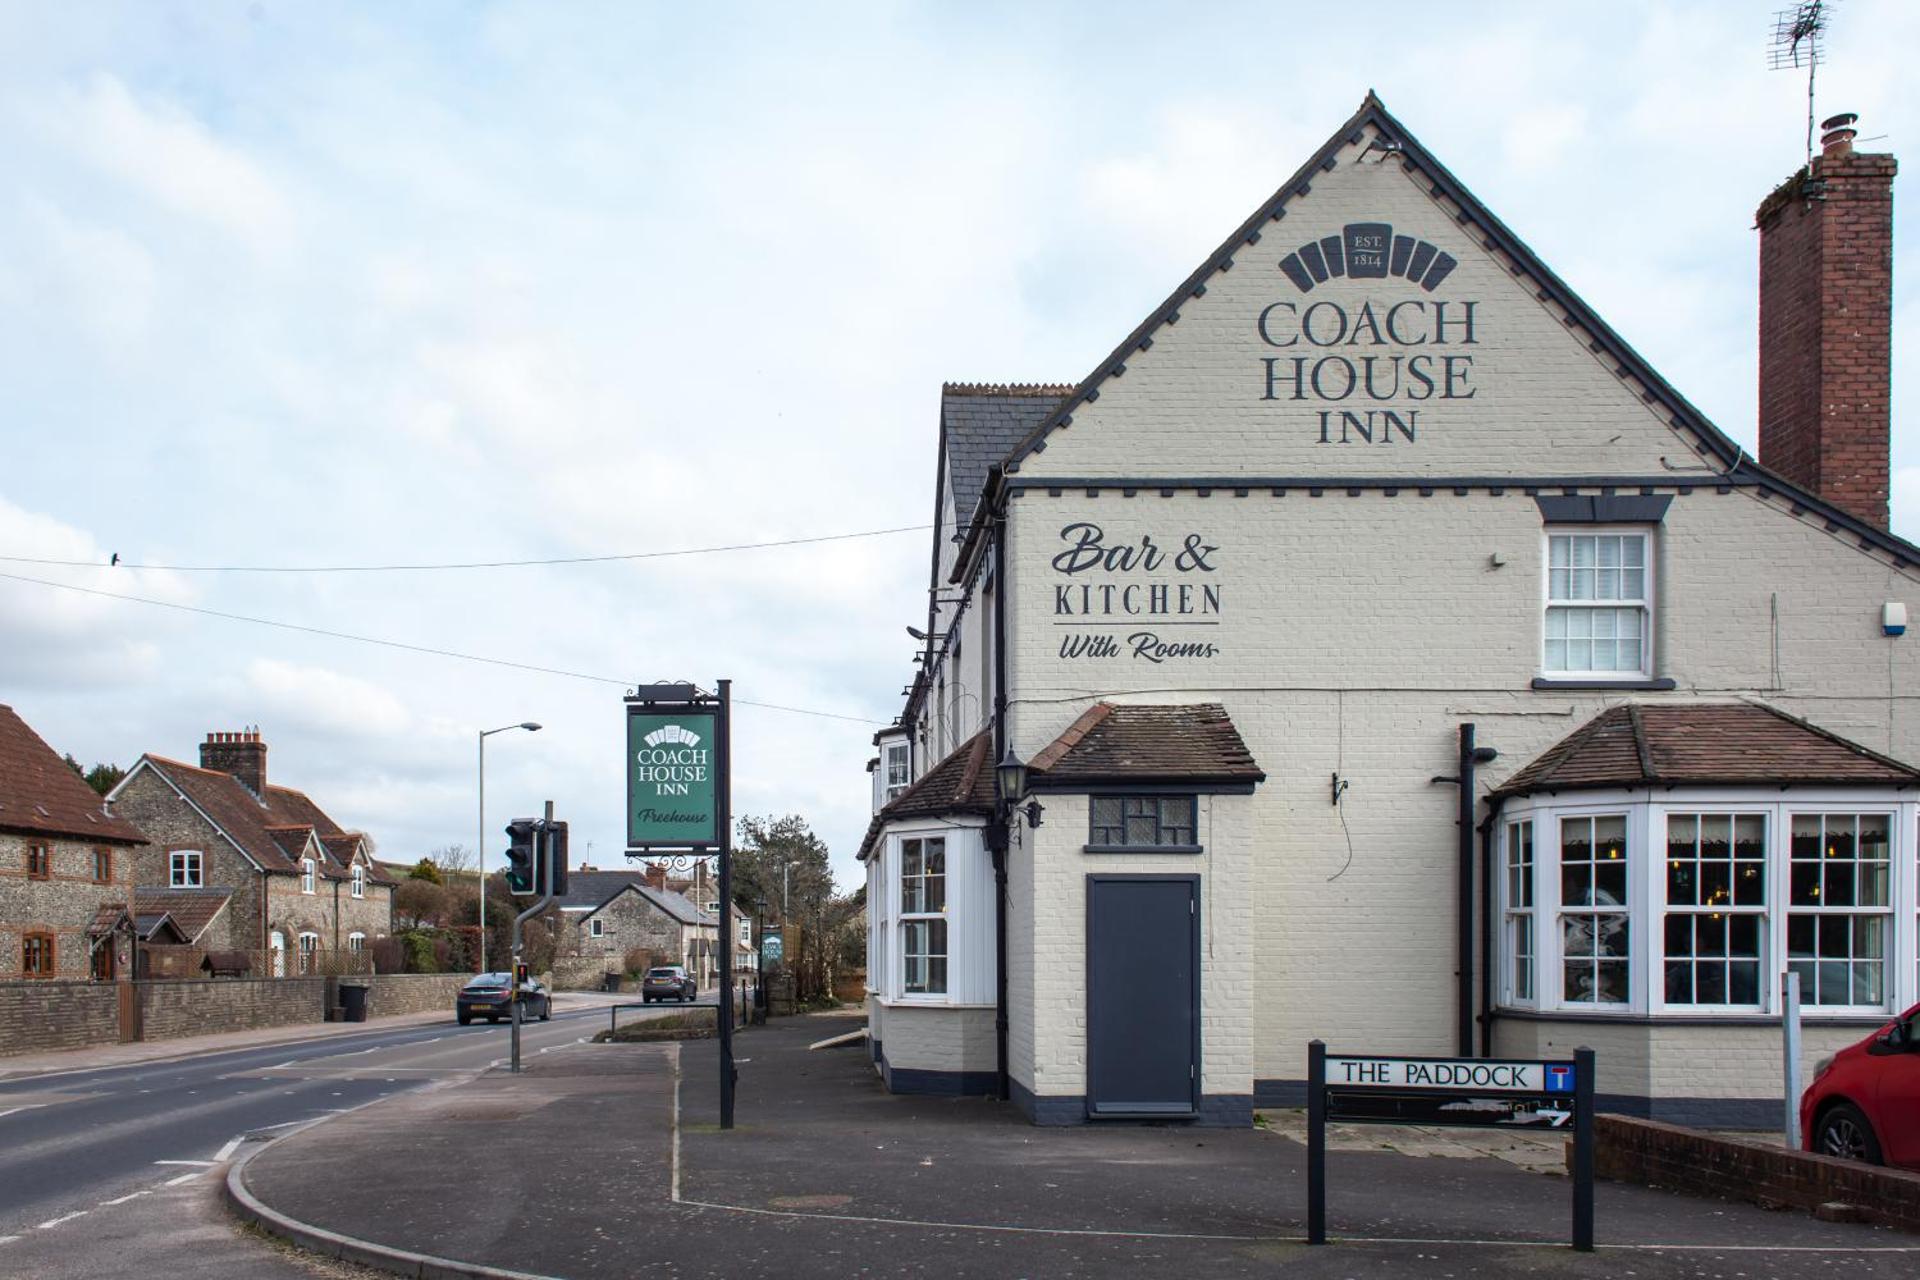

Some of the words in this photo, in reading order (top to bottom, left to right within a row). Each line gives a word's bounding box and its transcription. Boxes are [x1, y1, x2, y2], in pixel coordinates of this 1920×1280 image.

[1354, 235, 1382, 248] EST.
[1354, 254, 1382, 267] 1814
[1257, 300, 1480, 347] COACH
[1259, 355, 1477, 400] HOUSE
[1316, 410, 1420, 444] INN
[1051, 522, 1166, 576] Bar
[1174, 533, 1221, 573] &
[1053, 584, 1222, 615] KITCHEN
[1059, 634, 1121, 659] With
[1127, 632, 1220, 664] Rooms
[637, 749, 708, 765] COACH
[638, 766, 708, 782] HOUSE
[656, 783, 689, 796] INN
[637, 808, 709, 824] Freehouse
[1341, 1062, 1390, 1083] THE
[1405, 1064, 1528, 1088] PADDOCK
